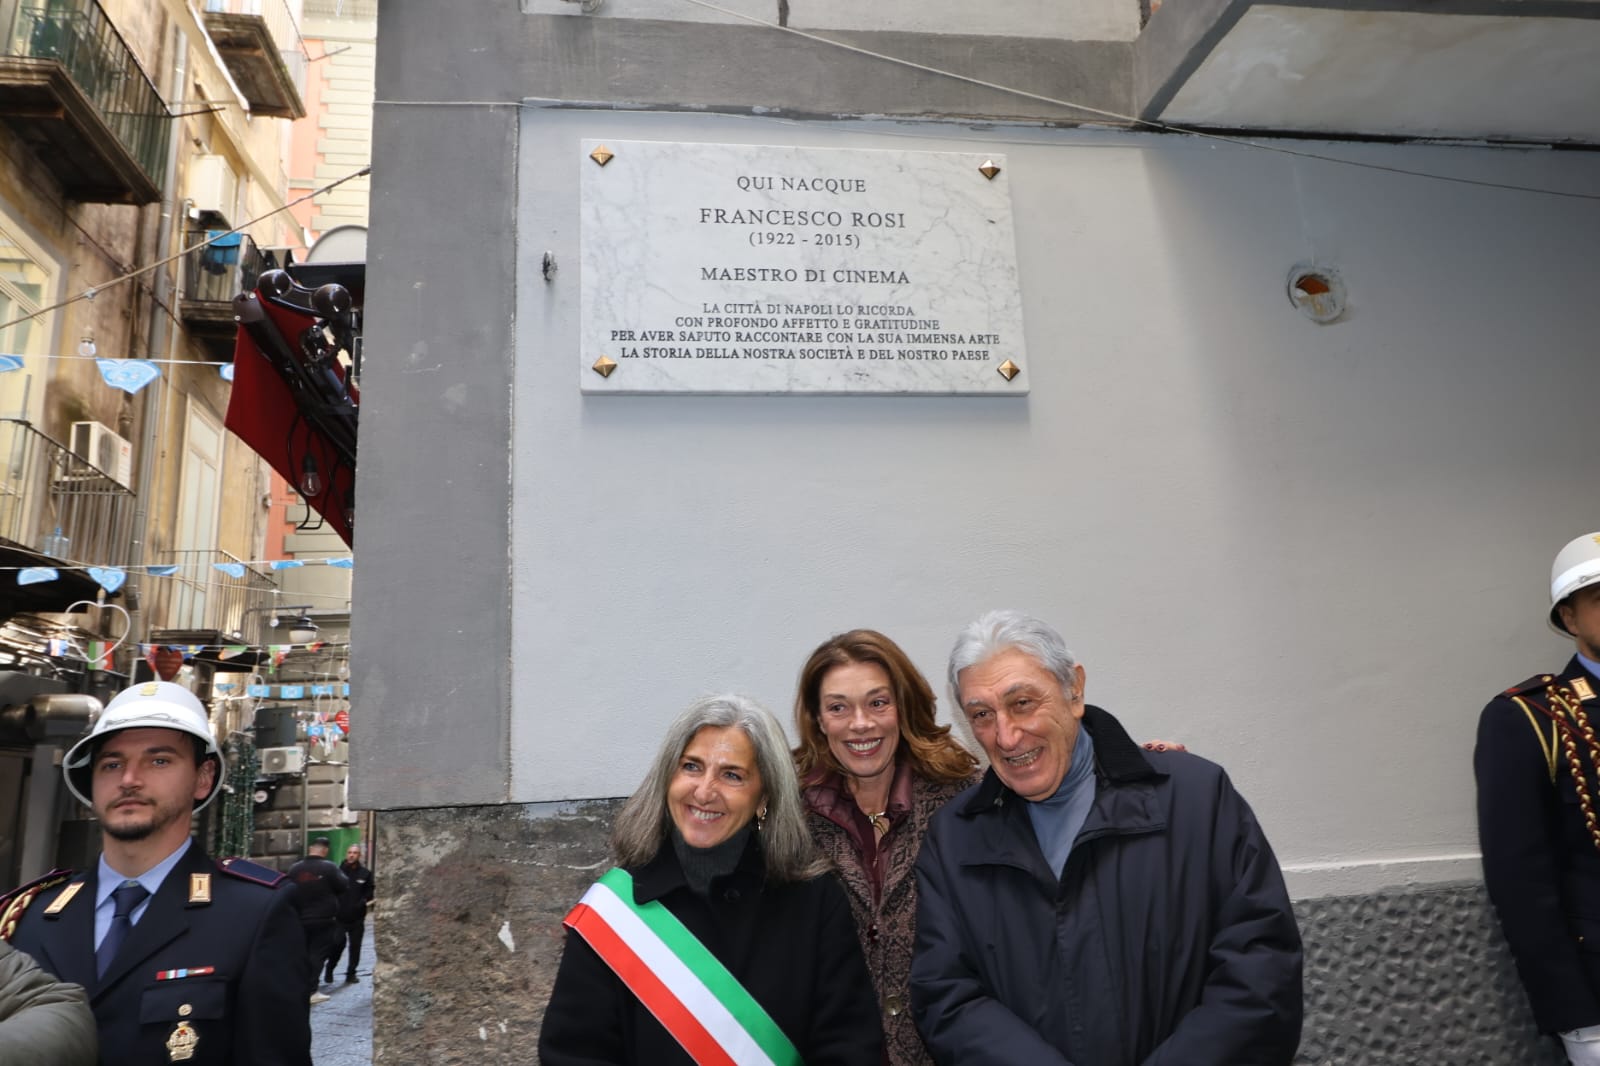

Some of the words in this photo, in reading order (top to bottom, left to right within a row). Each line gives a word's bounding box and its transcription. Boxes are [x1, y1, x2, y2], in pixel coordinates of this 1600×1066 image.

[737, 176, 773, 193] QUI
[781, 177, 866, 194] NACQUE
[700, 208, 842, 227] FRANCESCO
[852, 212, 906, 228] ROSI
[749, 232, 794, 246] (1922
[815, 233, 860, 249] 2015)
[701, 267, 797, 282] MAESTRO
[805, 269, 825, 282] DI
[833, 270, 910, 283] CINEMA
[703, 303, 720, 314] LA
[724, 301, 762, 314] CITTÀ
[767, 304, 781, 314] DI
[784, 304, 832, 315] NAPOLI
[837, 305, 853, 315] LO
[858, 305, 914, 316] RICORDA
[675, 317, 702, 328] CON
[708, 318, 777, 329] PROFONDO
[783, 318, 838, 329] AFFETTO
[843, 319, 850, 329] E
[855, 319, 939, 330] GRATITUDINE
[611, 330, 636, 341] PER
[640, 330, 675, 342] AVER
[679, 331, 731, 342] SAPUTO
[736, 332, 823, 343] RACCONTARE
[827, 333, 853, 343] CON
[858, 333, 874, 343] LA
[878, 333, 903, 344] SUA
[907, 333, 965, 344] IMMENSA
[969, 334, 1000, 344] ARTE
[621, 348, 639, 358] LA
[643, 348, 692, 359] STORIA
[696, 348, 739, 359] DELLA
[743, 348, 795, 359] NOSTRA
[799, 346, 853, 360] SOCIETÀ
[858, 349, 865, 359] E
[870, 349, 893, 360] DEL
[898, 350, 947, 361] NOSTRO
[952, 350, 989, 361] PAESE
